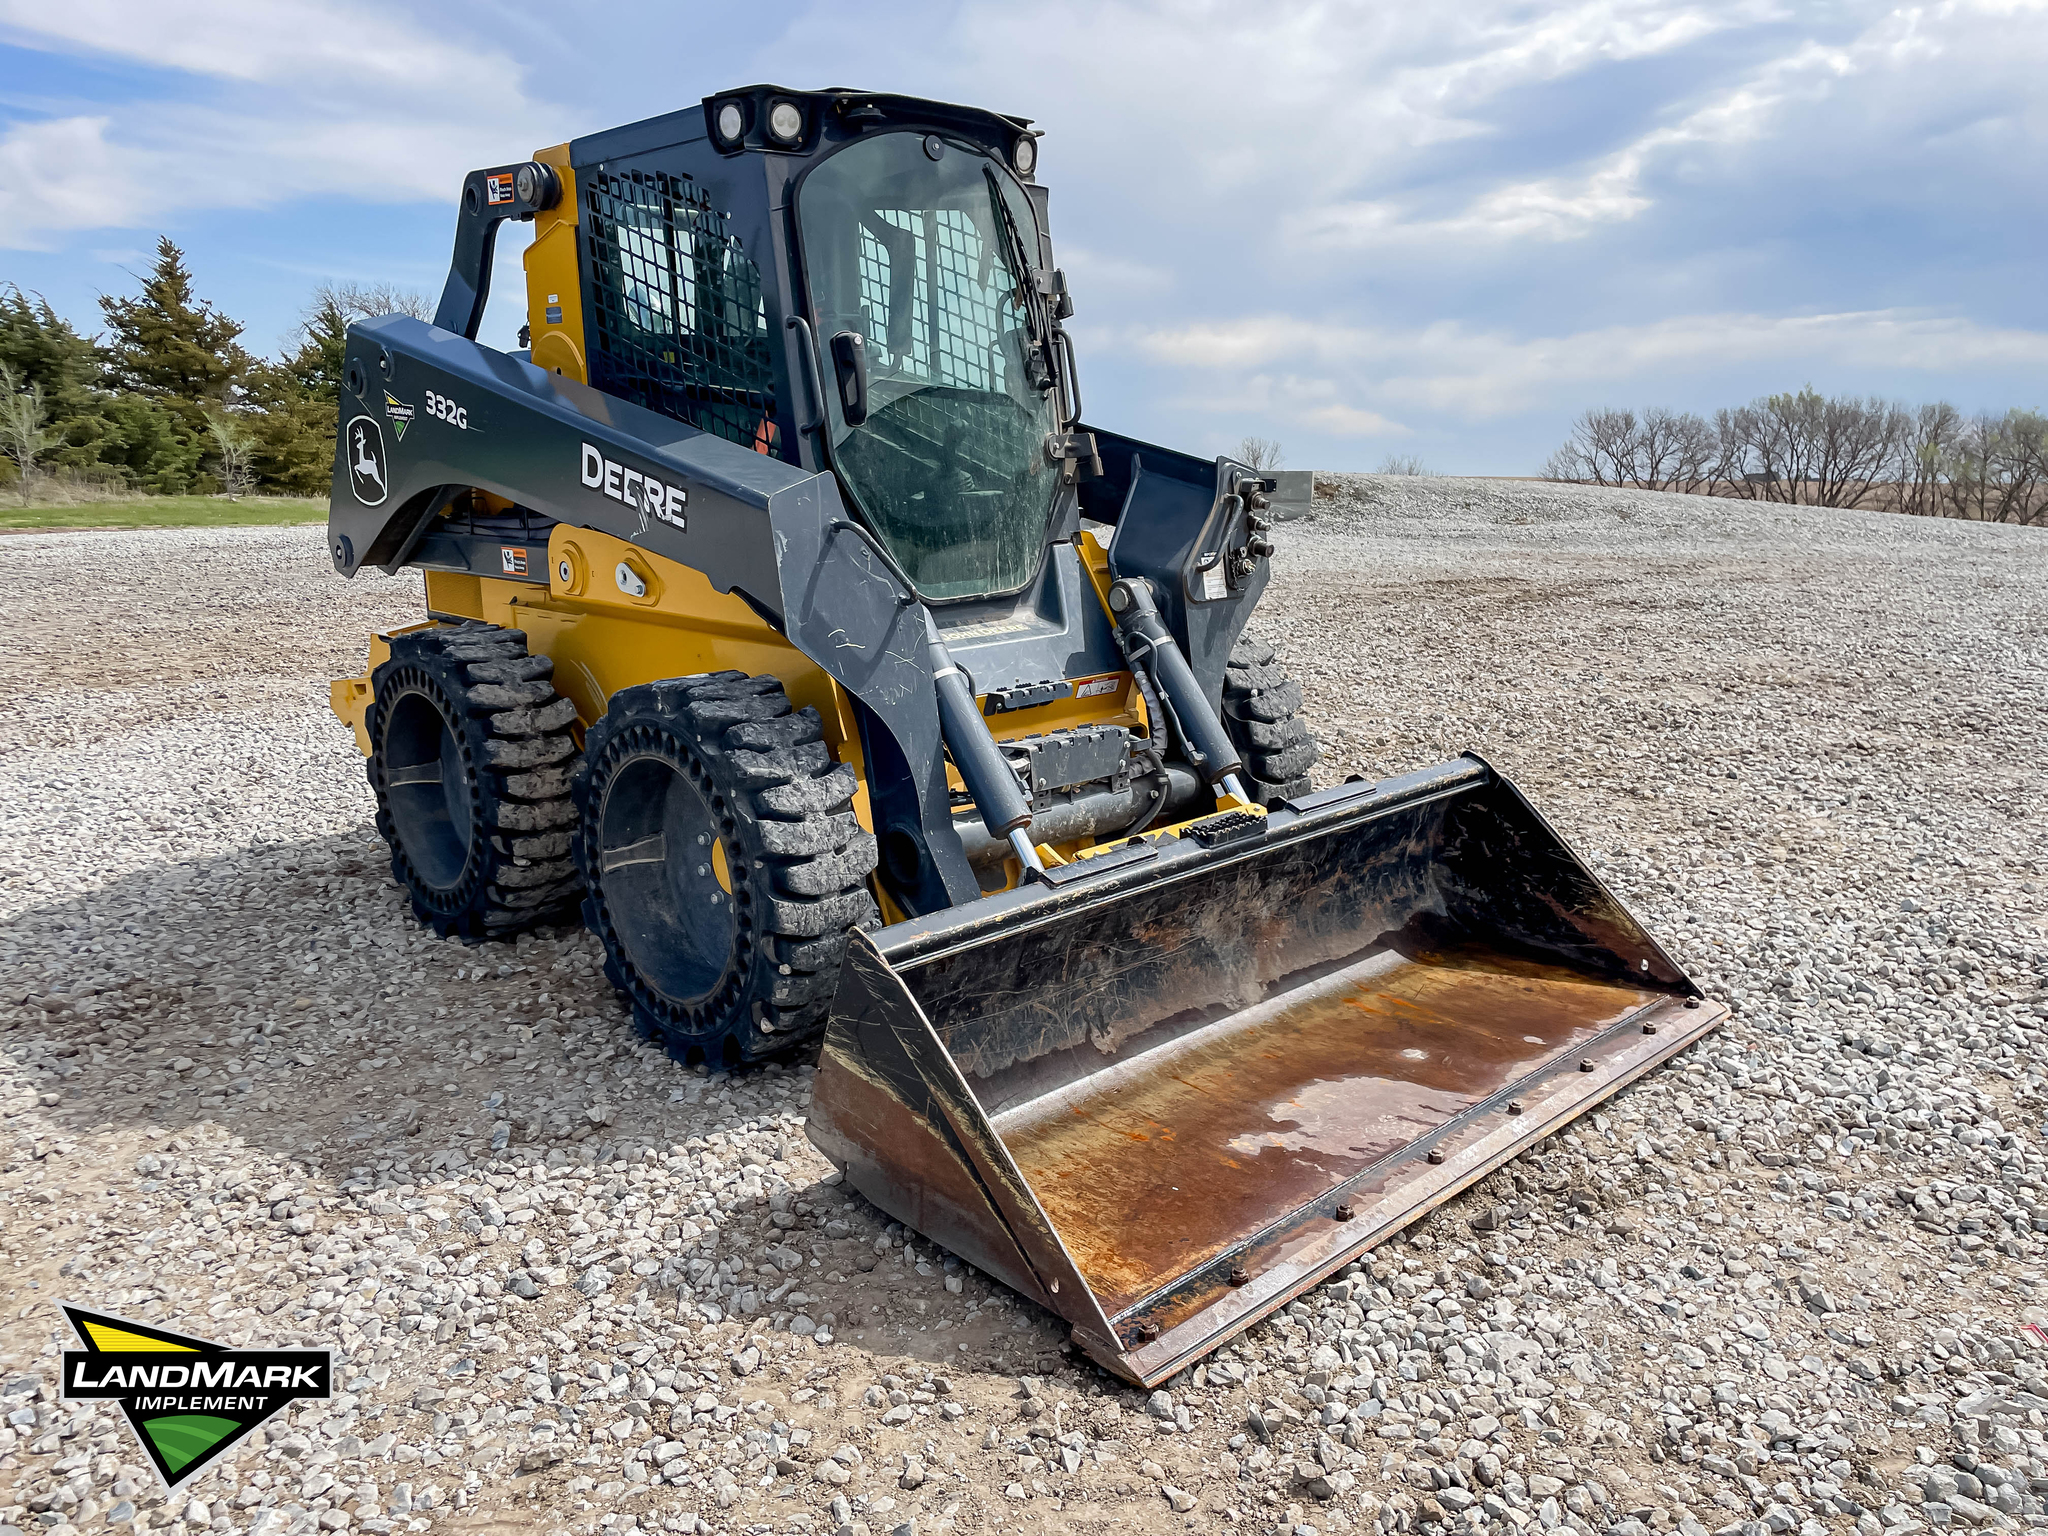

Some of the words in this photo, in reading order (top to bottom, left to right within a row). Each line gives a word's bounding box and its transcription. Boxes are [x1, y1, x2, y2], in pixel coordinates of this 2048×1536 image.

[425, 390, 467, 430] 332G
[582, 442, 686, 528] DEERE
[941, 630, 979, 641] JOHN
[980, 623, 1031, 637] DEERE
